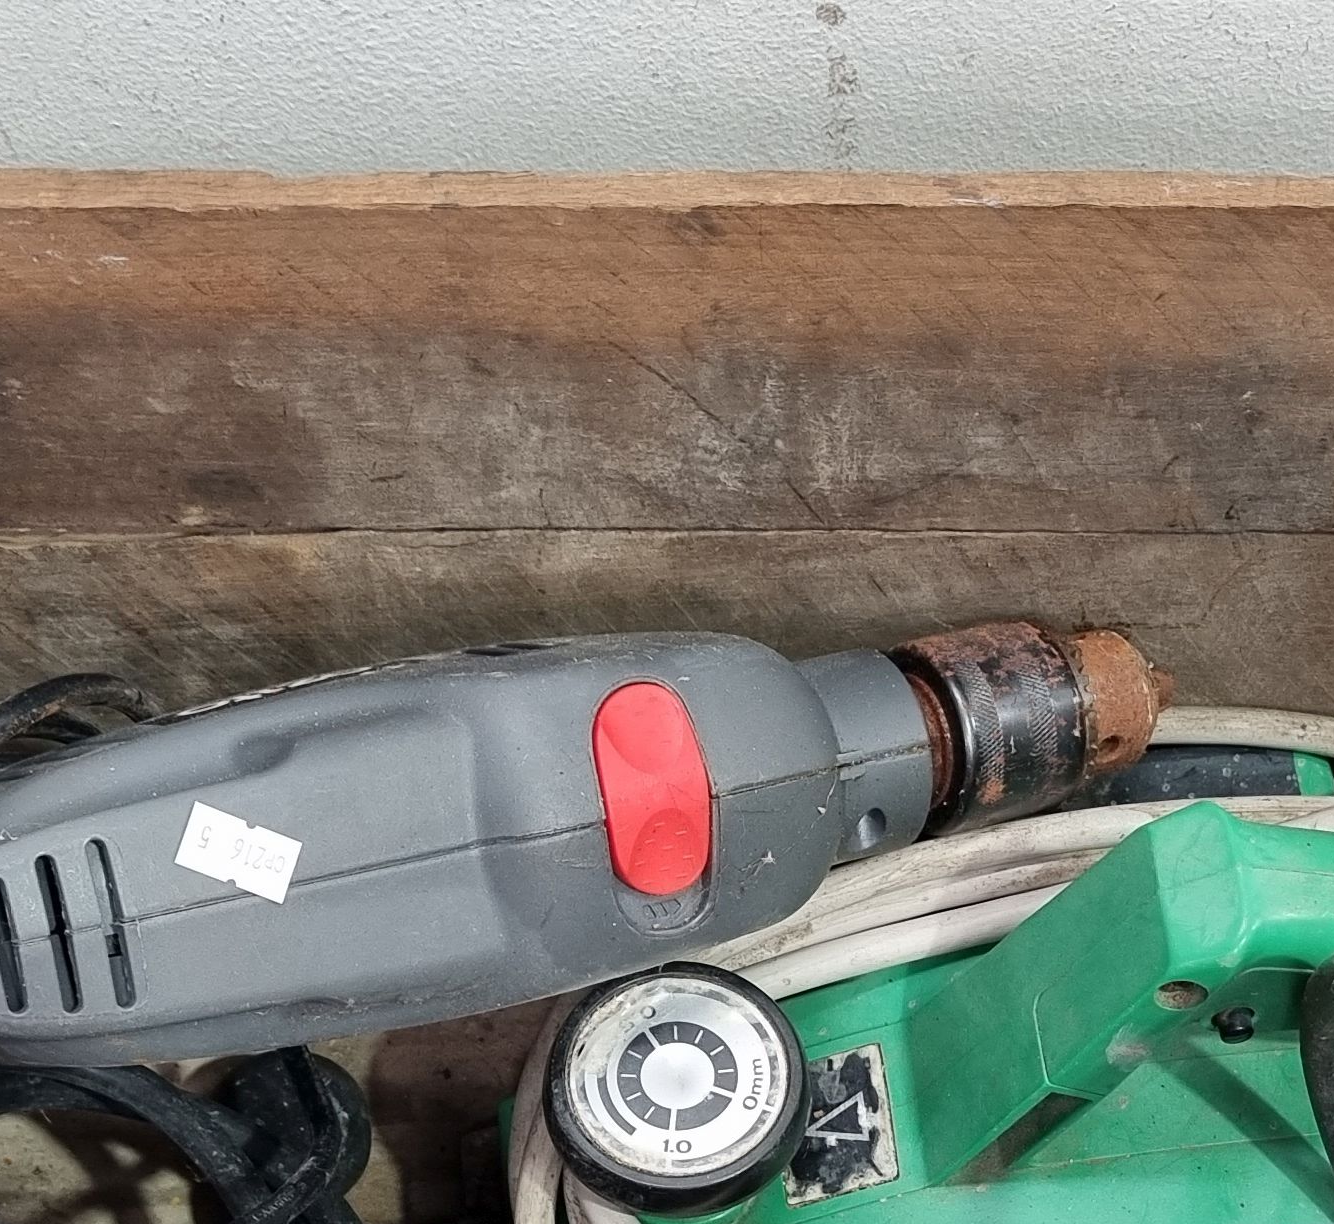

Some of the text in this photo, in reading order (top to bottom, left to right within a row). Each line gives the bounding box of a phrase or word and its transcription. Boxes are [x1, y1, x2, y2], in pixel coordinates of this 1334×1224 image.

[197, 825, 285, 874] CP216 5
[742, 1057, 763, 1112] 0mm
[662, 1138, 693, 1155] 1.0
